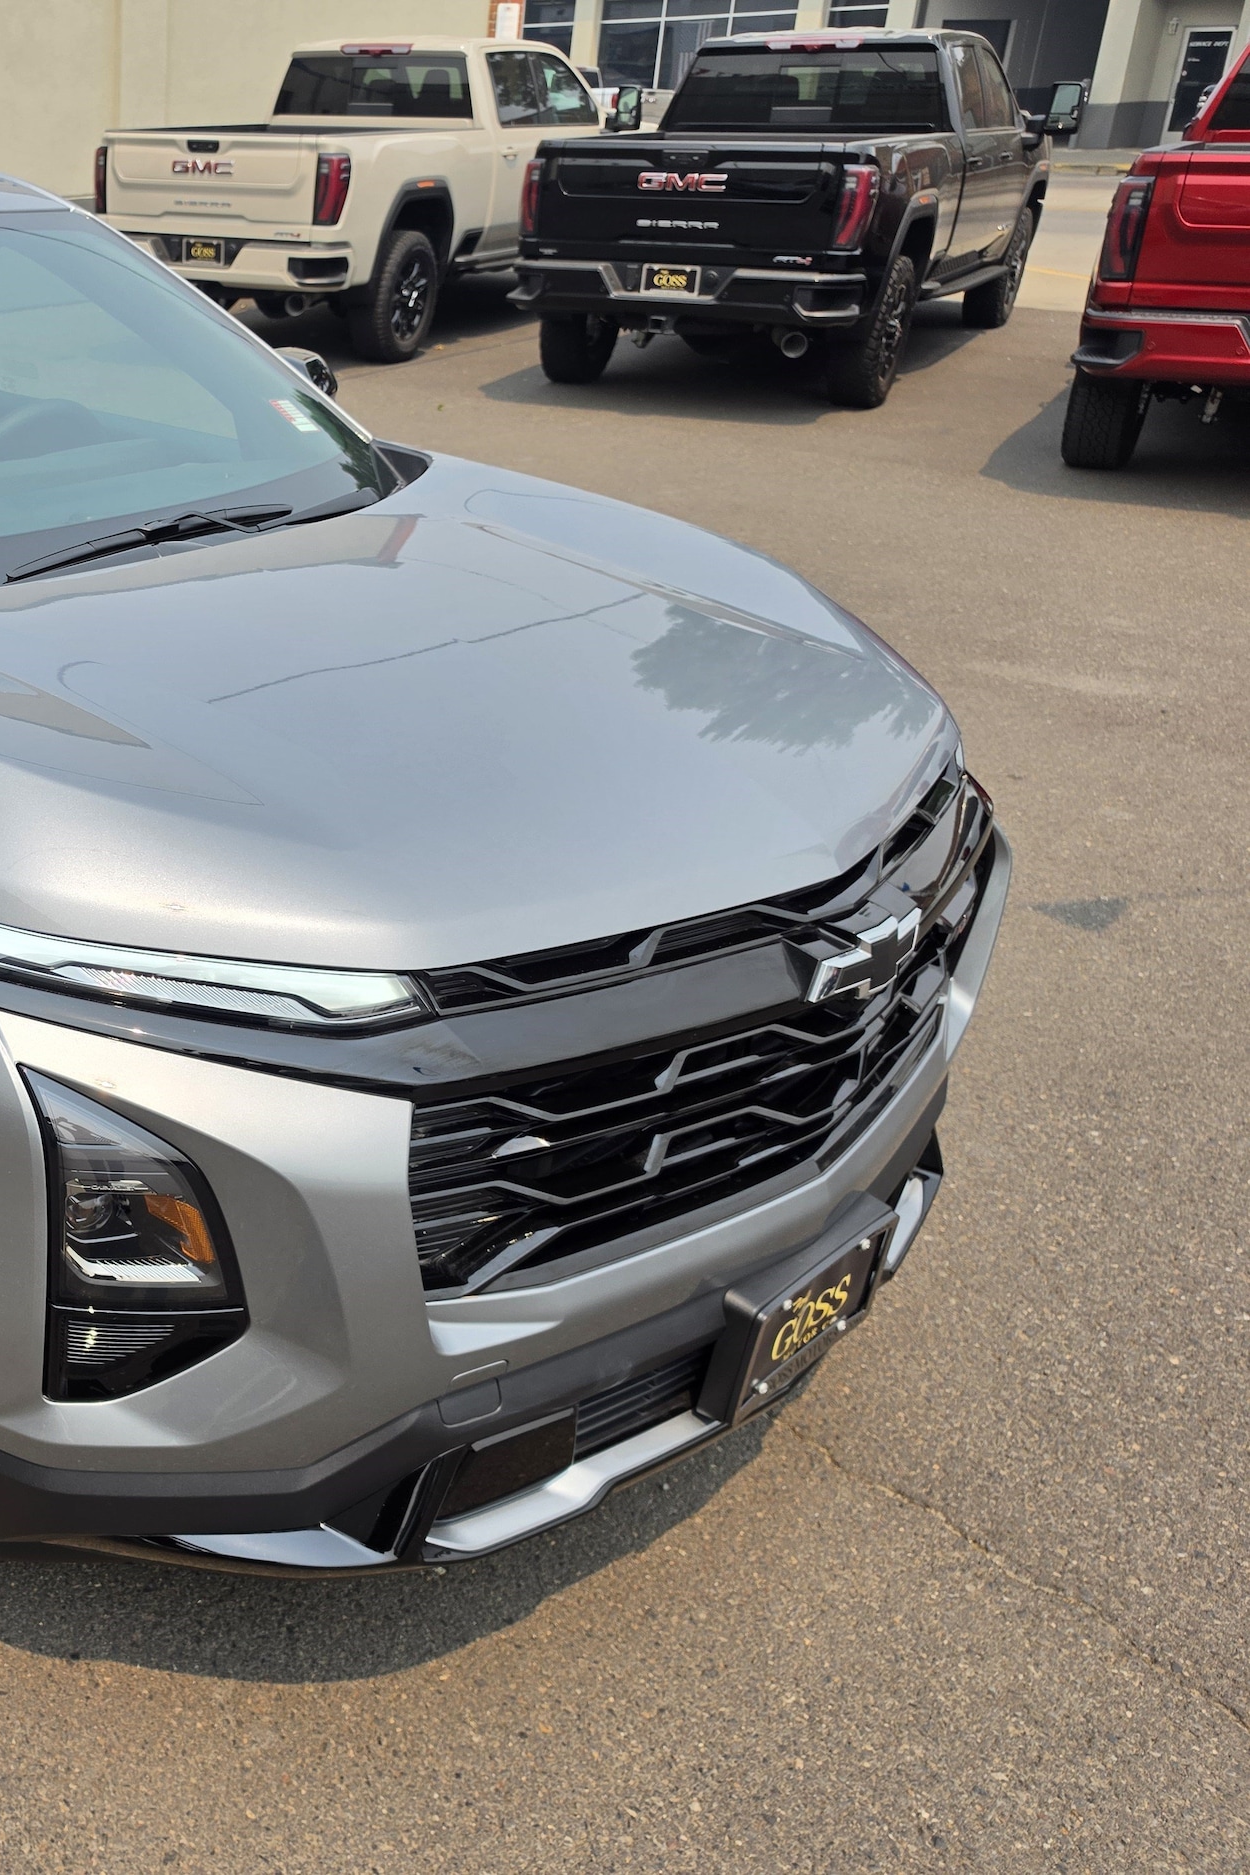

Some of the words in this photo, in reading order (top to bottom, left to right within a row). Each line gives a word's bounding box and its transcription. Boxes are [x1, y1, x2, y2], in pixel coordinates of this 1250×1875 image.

[172, 160, 234, 175] GMC
[637, 172, 728, 192] GMC
[636, 219, 719, 229] SIERRA
[190, 246, 216, 258] GOSS
[653, 273, 688, 288] GOSS
[771, 1273, 852, 1361] GOSS
